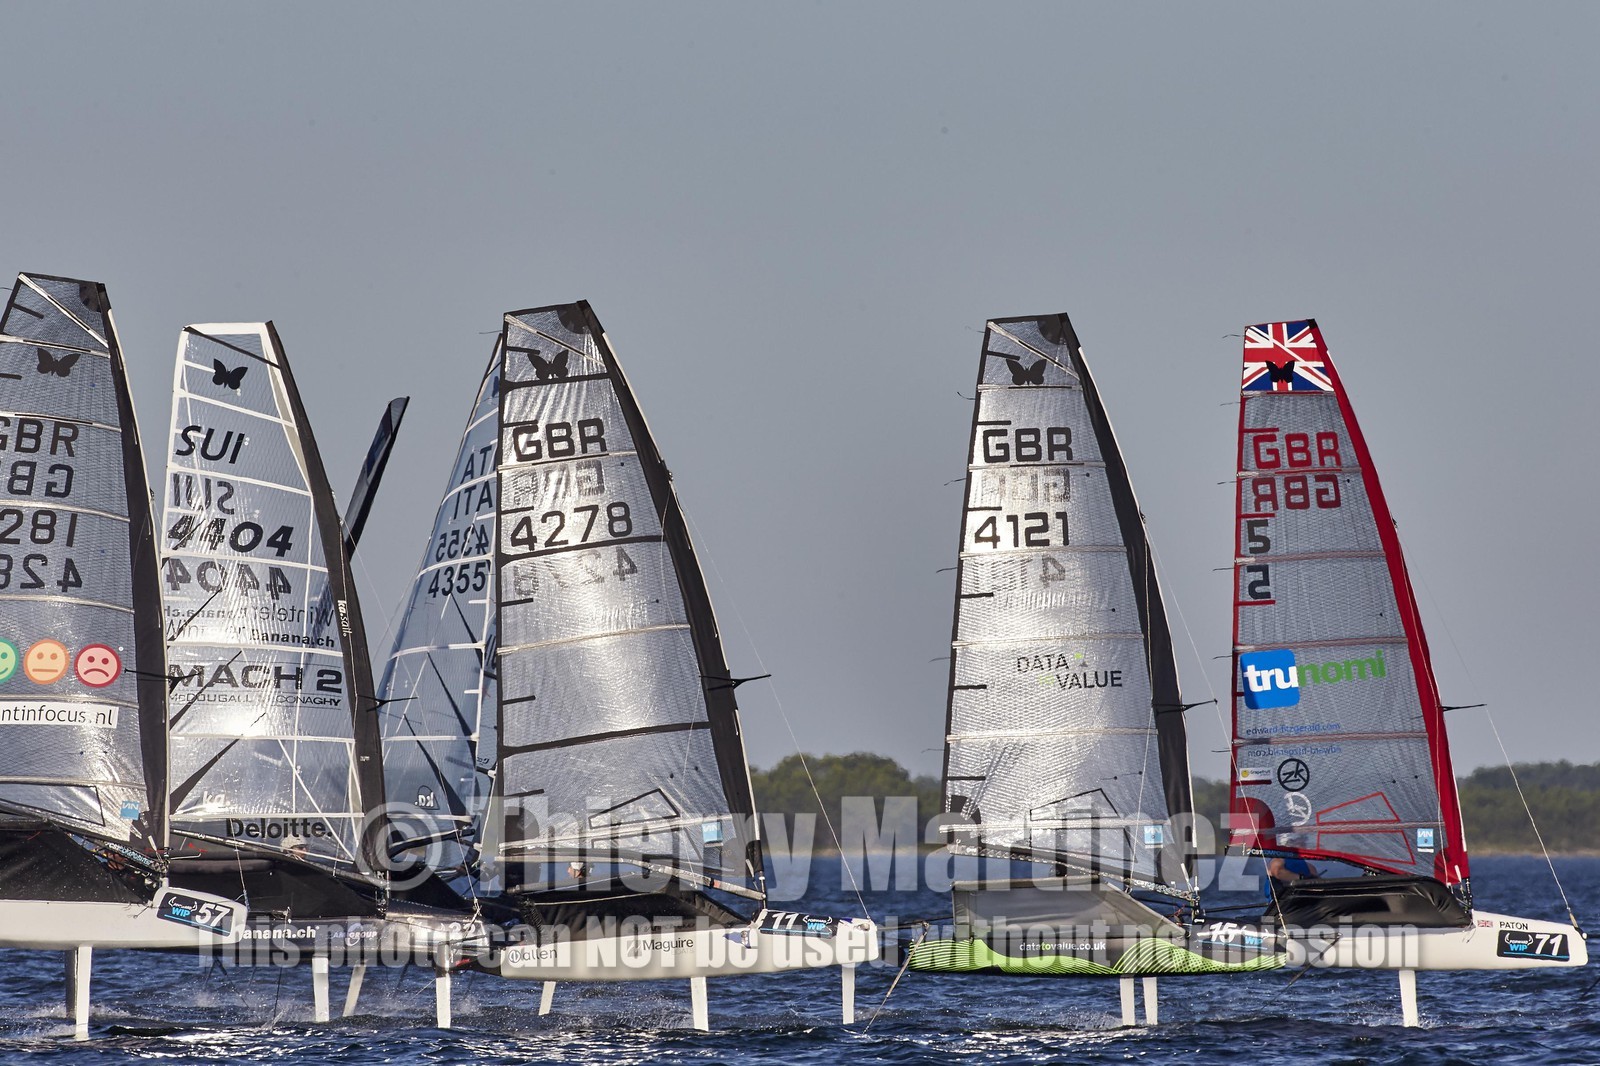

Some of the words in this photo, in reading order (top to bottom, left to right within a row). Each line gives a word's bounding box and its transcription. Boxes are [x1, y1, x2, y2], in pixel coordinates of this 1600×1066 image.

[175, 425, 246, 465] SUI
[513, 417, 607, 462] GBR
[983, 427, 1073, 463] GBR
[1253, 431, 1341, 469] GBR
[454, 481, 493, 519] ITA
[168, 515, 294, 557] 4404
[510, 502, 632, 551] 4278
[974, 511, 1070, 549] 4121
[1246, 519, 1271, 554] 5
[428, 562, 486, 598] 4355
[1017, 653, 1069, 673] DATA
[1243, 649, 1386, 692] trunomi
[169, 664, 302, 690] MACH
[316, 669, 342, 694] 2
[1056, 670, 1122, 690] VALUE
[226, 818, 333, 839] Deloitte.
[172, 907, 191, 917] WIP
[195, 902, 231, 927] 57
[772, 912, 799, 929] 11
[1500, 921, 1528, 930] PATON
[807, 922, 826, 930] WIP
[522, 948, 558, 960] allen
[643, 938, 693, 952] Maguire
[1019, 941, 1106, 951] datatovalue.co.uk
[1535, 934, 1562, 956] 71
